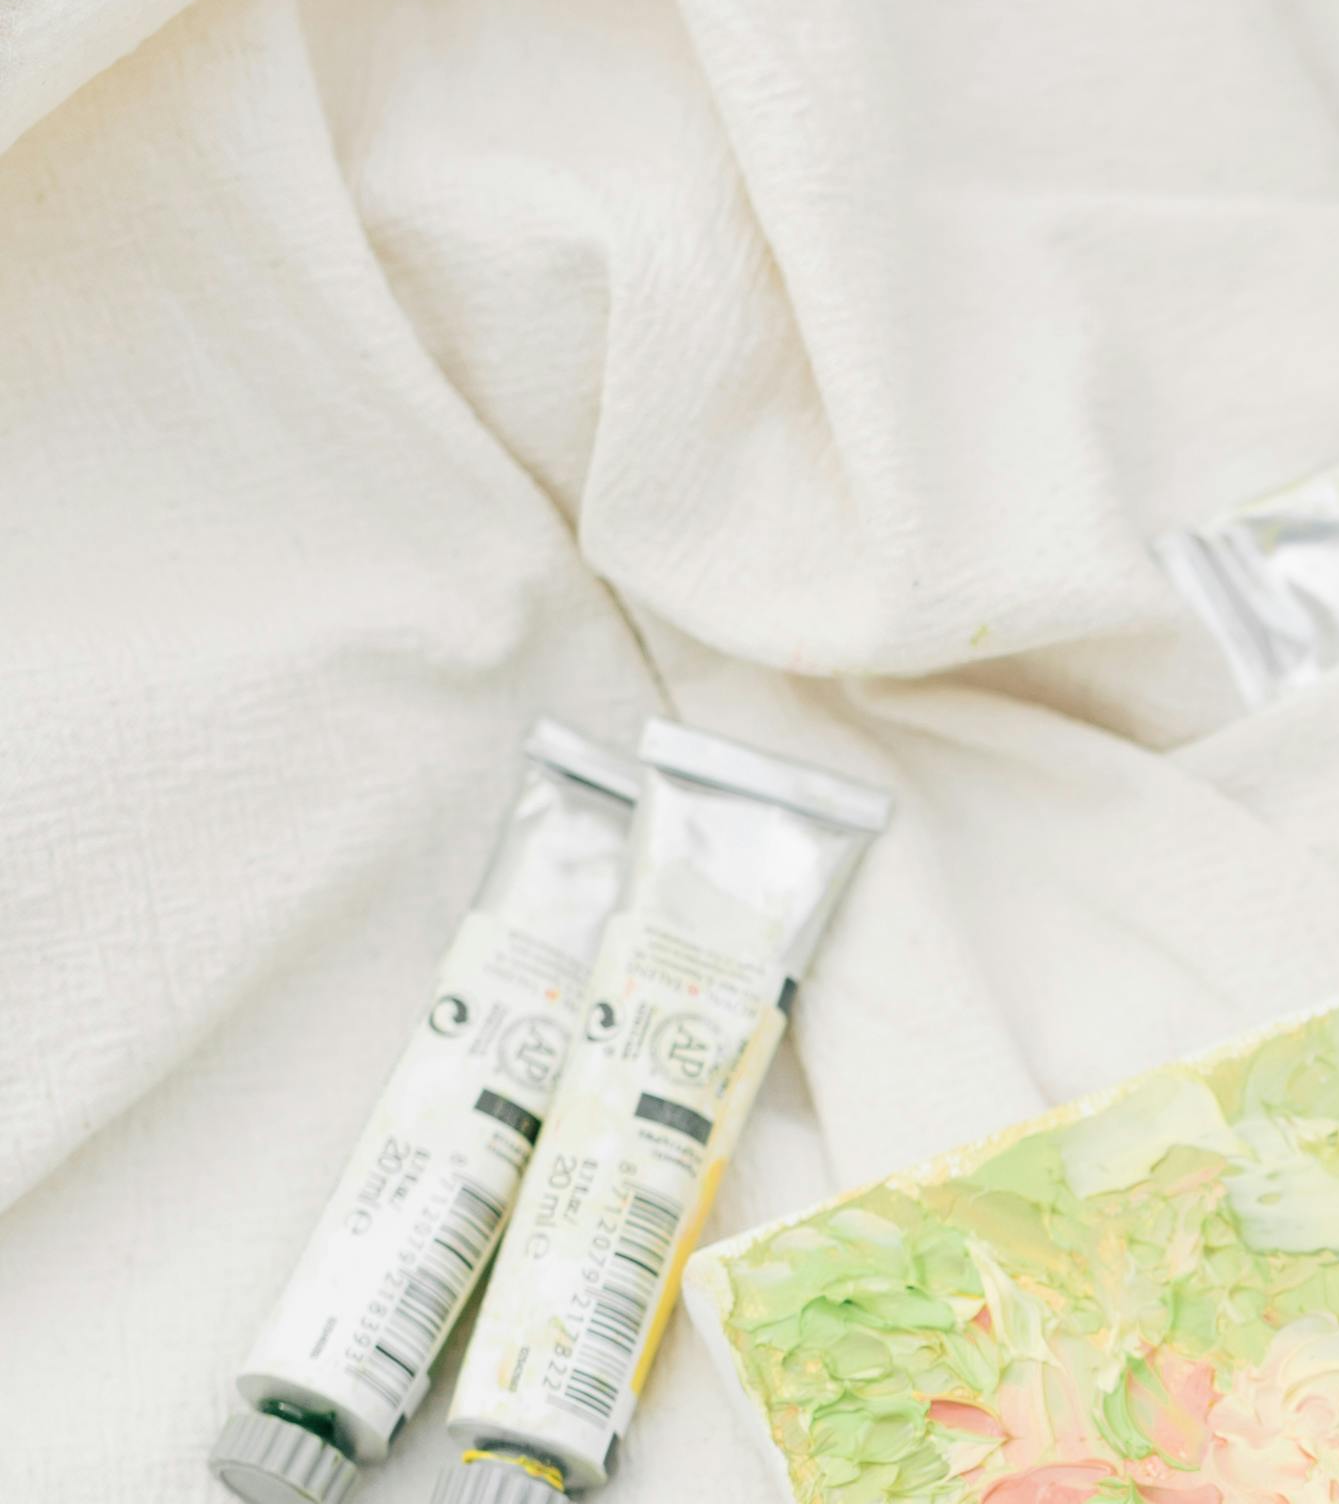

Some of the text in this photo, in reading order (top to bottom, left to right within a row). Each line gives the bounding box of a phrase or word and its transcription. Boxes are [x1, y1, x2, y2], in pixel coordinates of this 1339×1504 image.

[514, 1029, 556, 1083] AP
[668, 1024, 707, 1080] AP
[376, 1135, 412, 1175] 20
[546, 1153, 577, 1191] 20
[357, 1171, 394, 1209] ml
[534, 1192, 561, 1229] ml
[580, 1184, 630, 1284] 712079
[342, 1270, 407, 1367] 218393
[541, 1293, 591, 1392] 217822
